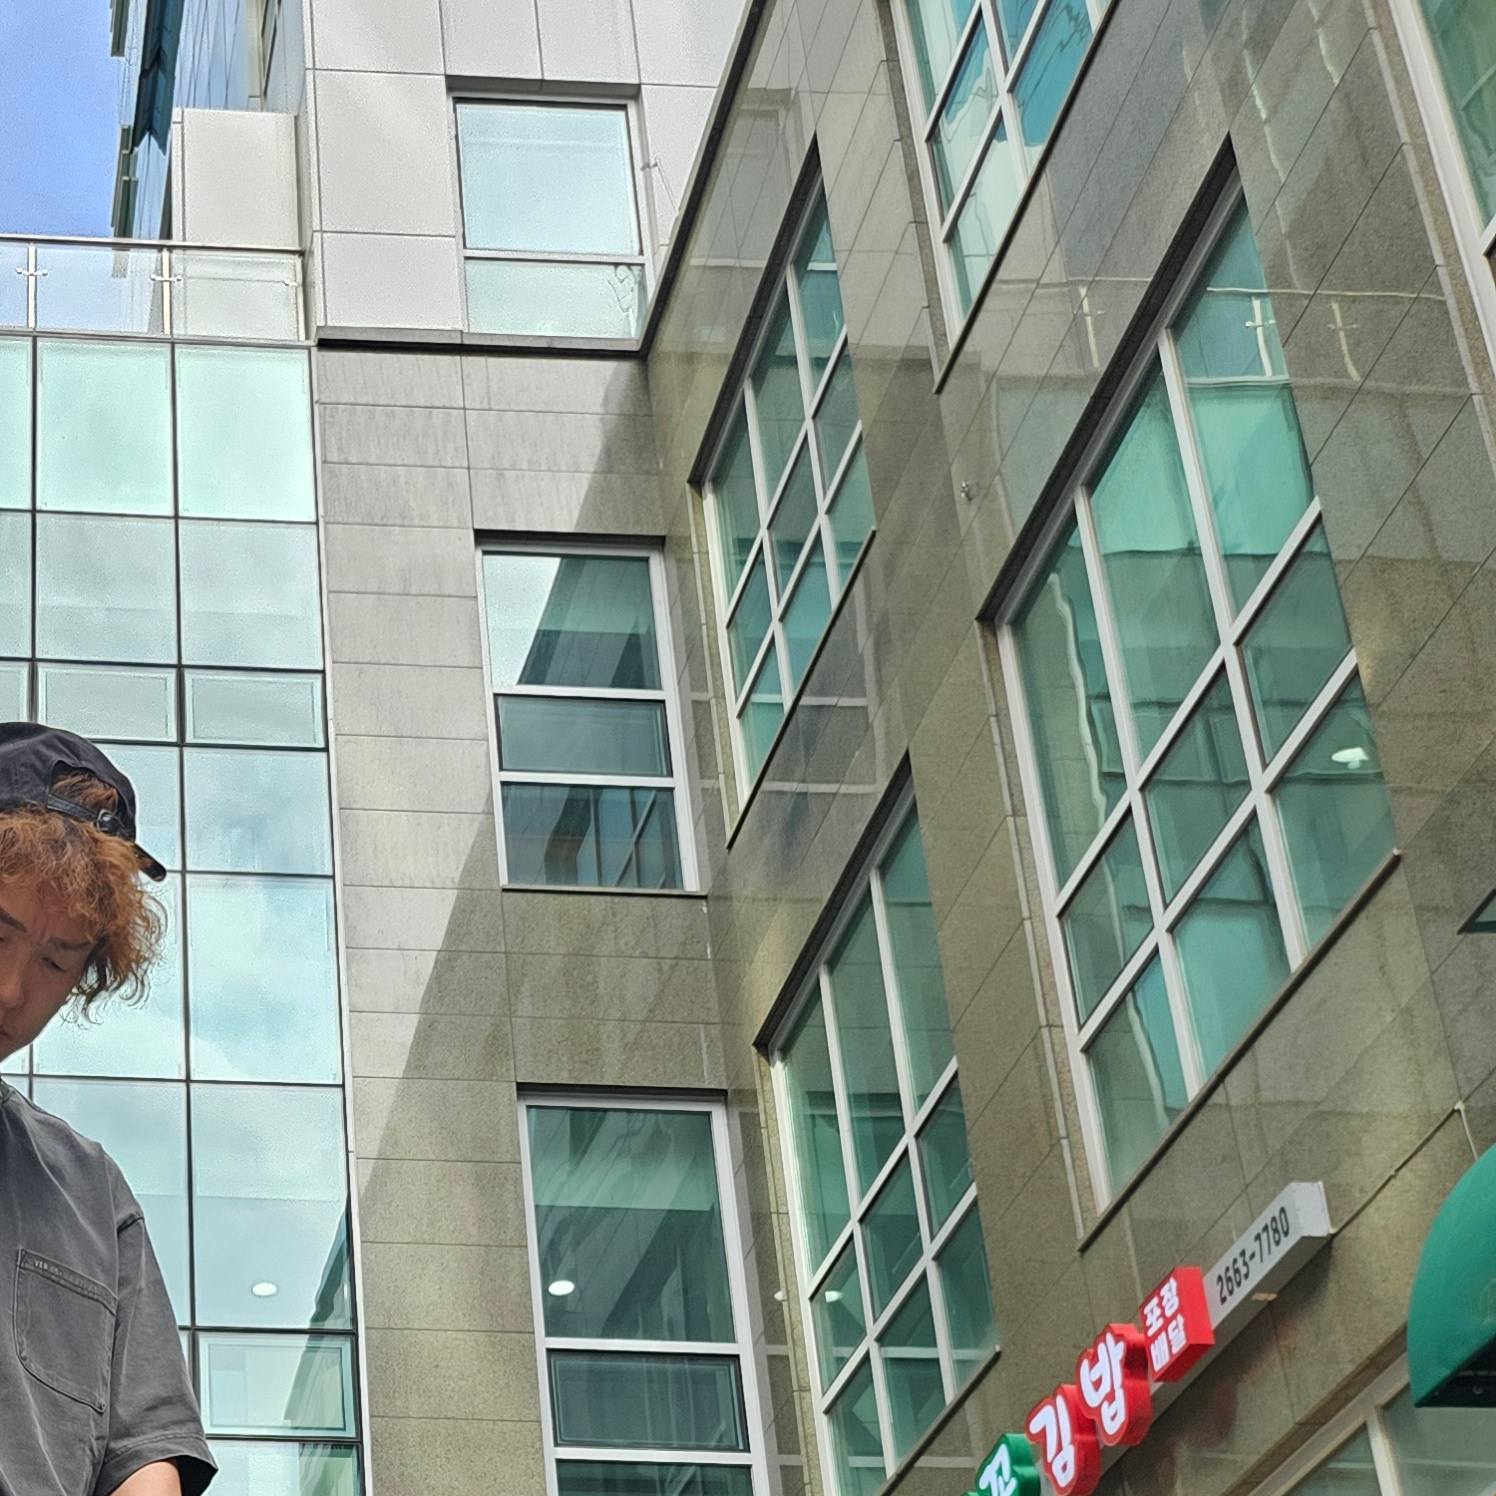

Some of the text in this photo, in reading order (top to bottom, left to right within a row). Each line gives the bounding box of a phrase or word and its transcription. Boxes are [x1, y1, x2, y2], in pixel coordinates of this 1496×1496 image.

[1215, 1207, 1291, 1306] 2663-7780
[1143, 1277, 1179, 1337] 포장
[1149, 1314, 1187, 1372] 배달
